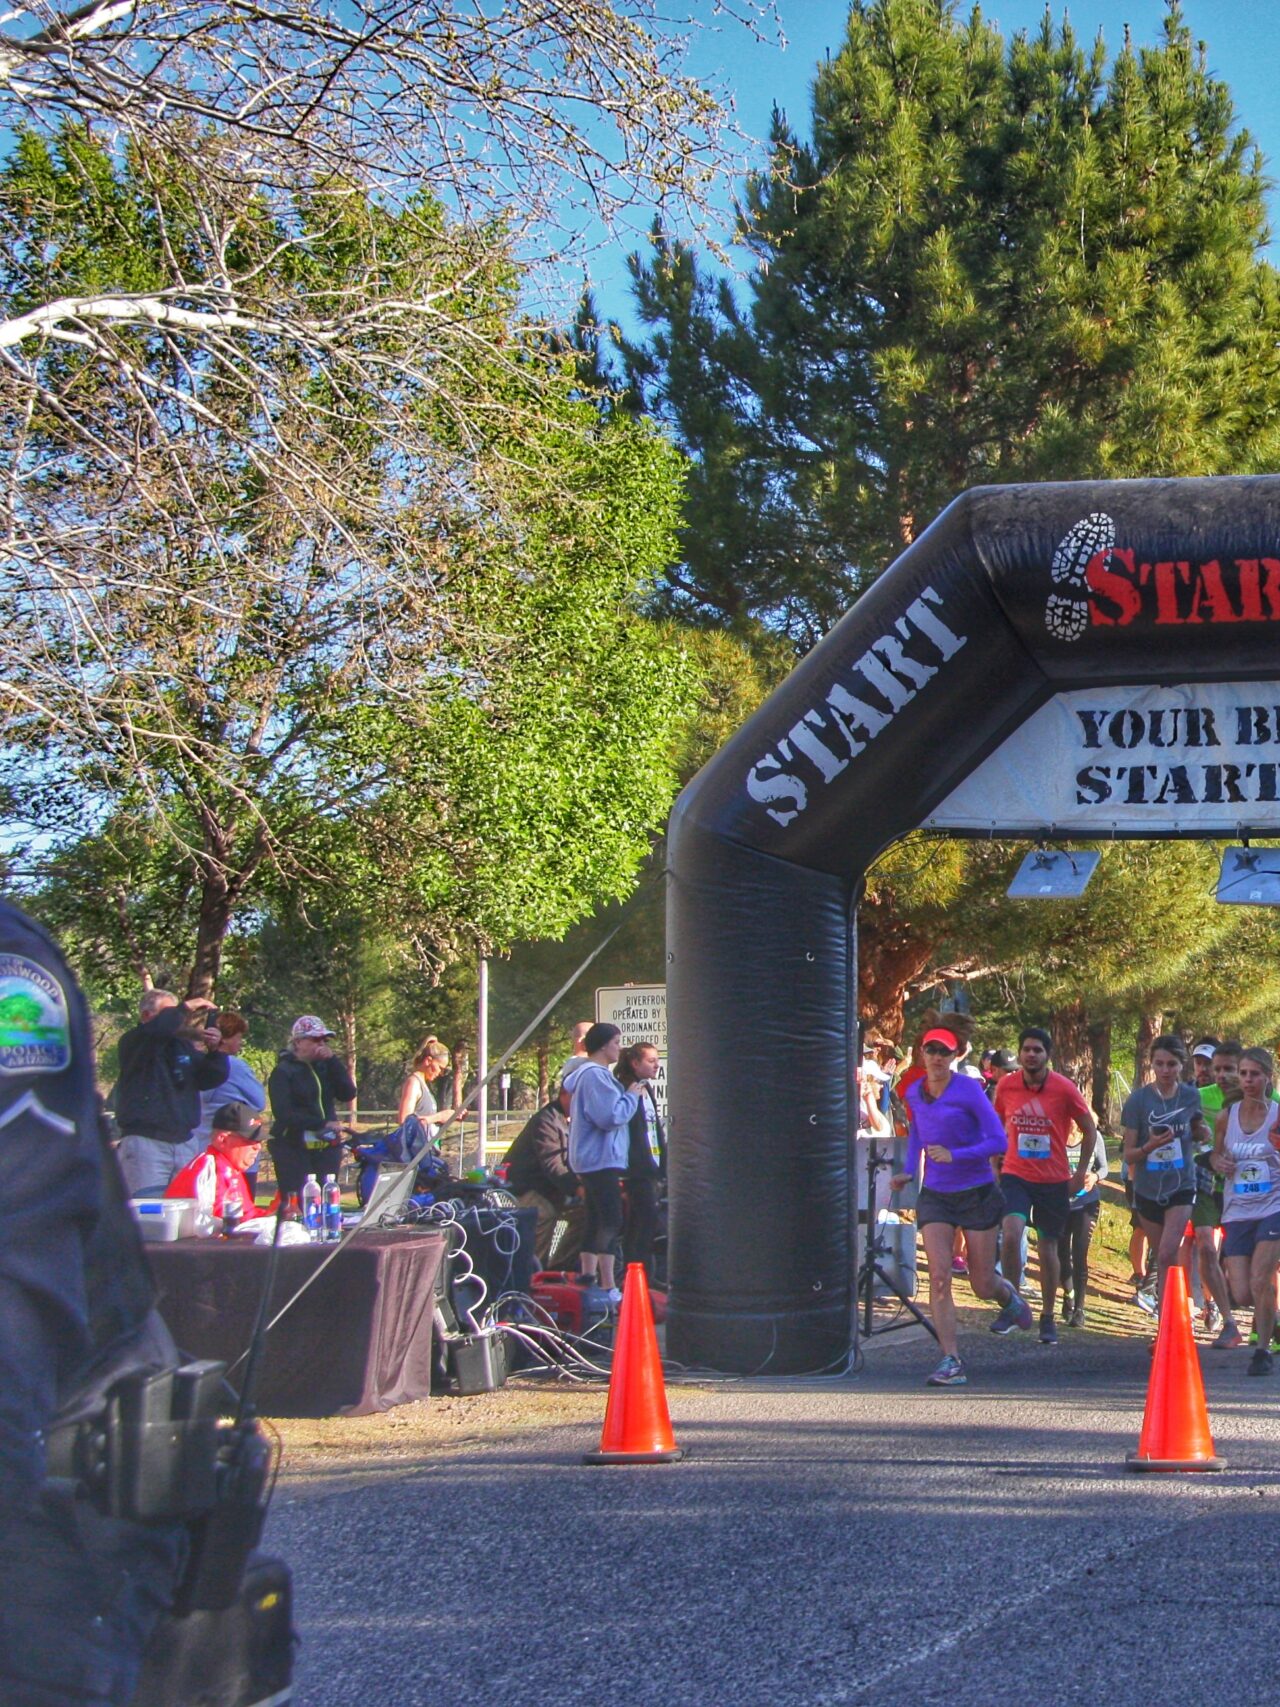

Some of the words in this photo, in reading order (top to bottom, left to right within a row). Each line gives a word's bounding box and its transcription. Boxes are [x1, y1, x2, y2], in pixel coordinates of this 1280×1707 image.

[747, 586, 968, 827] START
[1076, 708, 1221, 749] YOUR
[612, 1009, 648, 1021] OPERATED
[652, 1009, 661, 1019] BY
[621, 1022, 667, 1033] ORDINANCES
[1232, 1142, 1265, 1157] NIKE
[1243, 1183, 1260, 1193] 248
